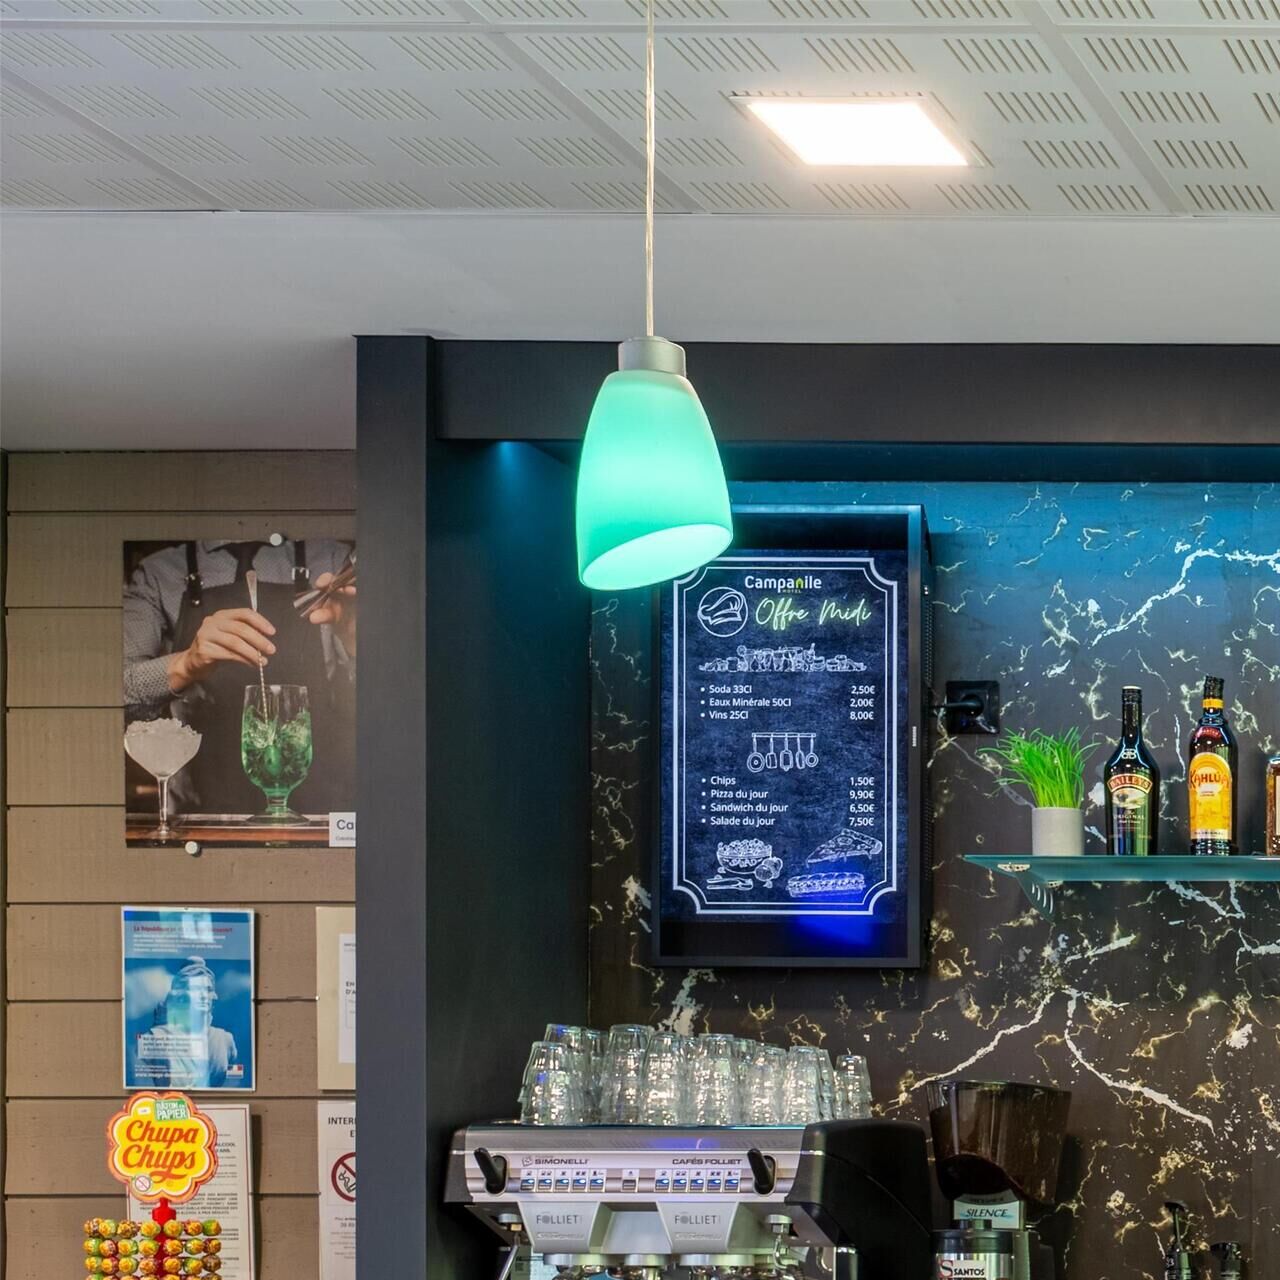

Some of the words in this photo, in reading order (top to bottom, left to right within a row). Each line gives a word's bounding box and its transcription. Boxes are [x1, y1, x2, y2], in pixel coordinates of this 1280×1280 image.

[745, 576, 822, 593] Campanile
[755, 598, 809, 631] Offre
[819, 599, 872, 626] Midi
[709, 684, 732, 694] Soda
[851, 685, 876, 695] 2,50€
[709, 698, 731, 707] Eaux
[732, 697, 771, 707] Minérale
[849, 698, 875, 708] 2,00€
[709, 710, 728, 720] Vins
[849, 711, 875, 721] 8,00€
[710, 776, 736, 786] Chips
[850, 776, 875, 787] 1,50€
[1109, 775, 1150, 789] BAILEYS
[711, 789, 734, 799] Pizza
[735, 789, 748, 799] du
[748, 789, 769, 801] jour
[849, 790, 875, 800] 9,90€
[710, 803, 754, 813] Sandwich
[755, 803, 768, 813] du
[768, 803, 789, 814] jour
[849, 803, 875, 814] 6,50€
[710, 816, 741, 826] Salade
[741, 816, 755, 826] du
[755, 816, 776, 828] jour
[849, 816, 875, 827] 7,50€
[156, 1108, 187, 1120] PAPIER
[126, 1119, 200, 1149] Chupa
[122, 1143, 197, 1178] Chups
[672, 1157, 703, 1165] CAFÉS
[966, 1208, 1009, 1218] SILENCE
[954, 1268, 985, 1276] SANTOS
